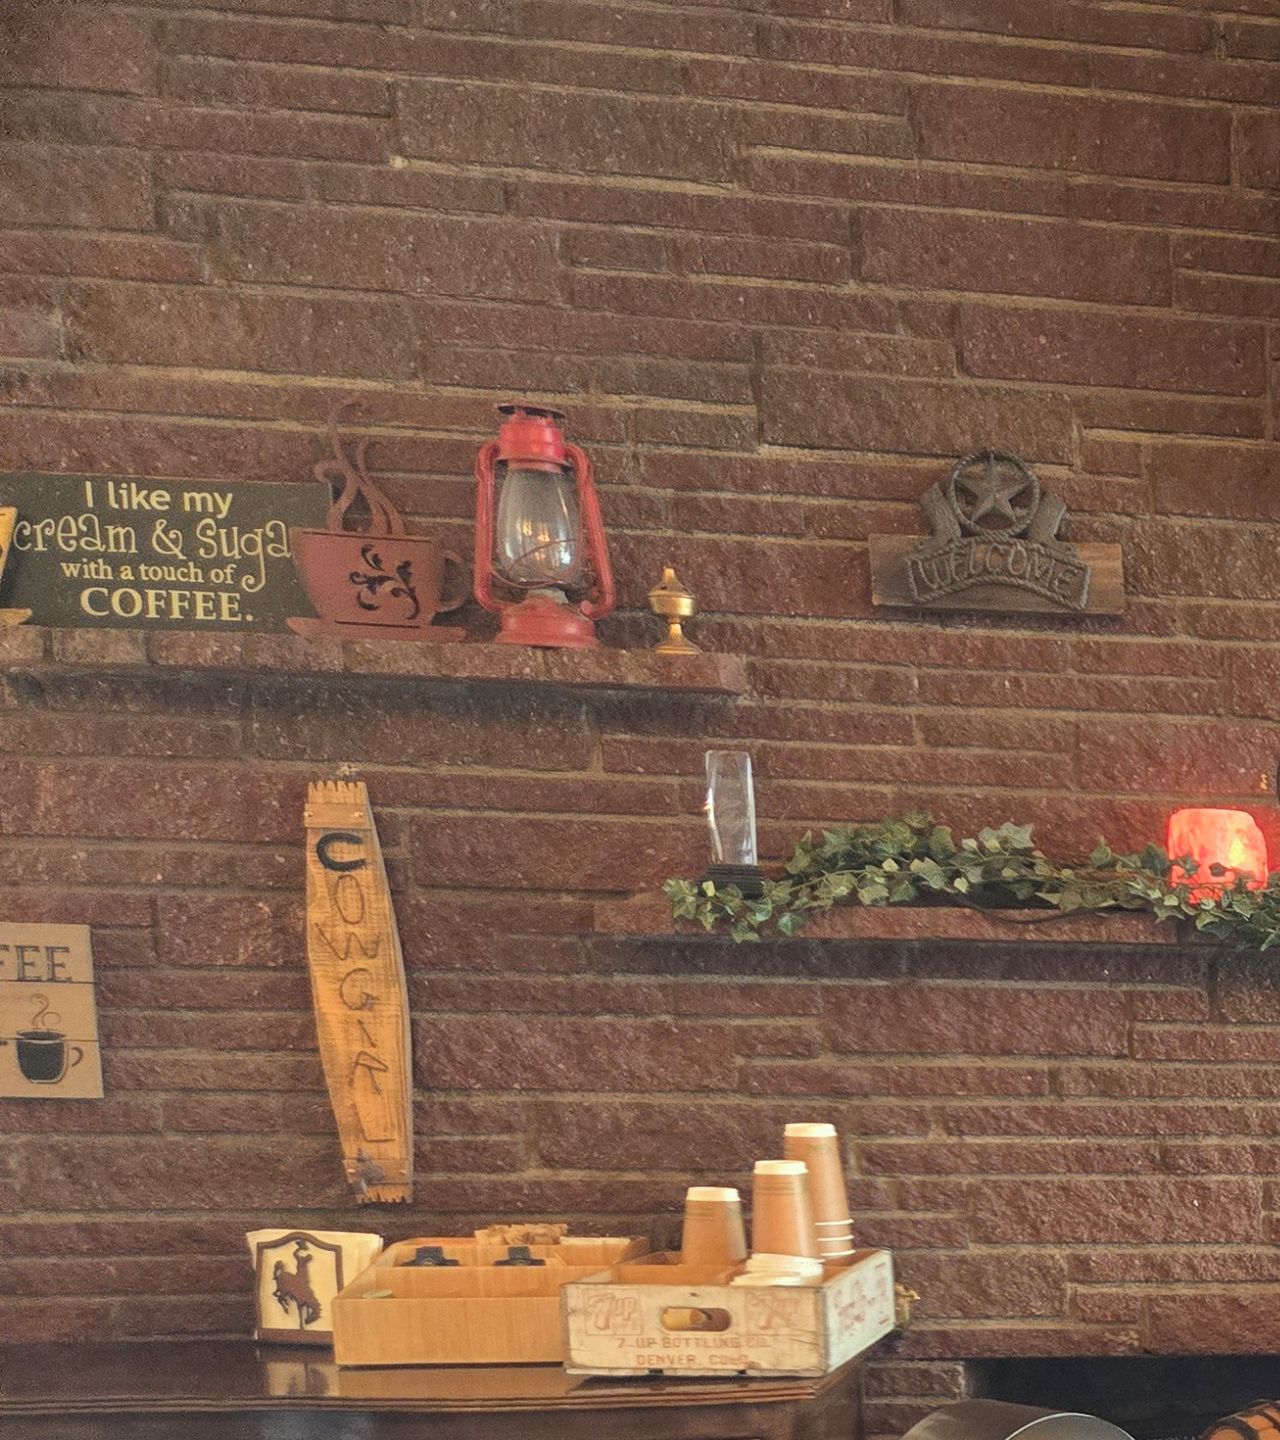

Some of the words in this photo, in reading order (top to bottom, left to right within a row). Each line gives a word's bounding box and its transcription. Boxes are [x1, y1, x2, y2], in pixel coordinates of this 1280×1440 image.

[84, 480, 94, 508] I
[107, 481, 171, 511] like
[183, 492, 233, 520] my
[13, 513, 138, 554] cream
[152, 518, 186, 560] &
[61, 559, 113, 580] with
[120, 564, 134, 580] a
[139, 560, 202, 583] touch
[209, 564, 237, 585] of
[80, 587, 254, 622] COFFEE.
[661, 1337, 741, 1348] BOTTLING
